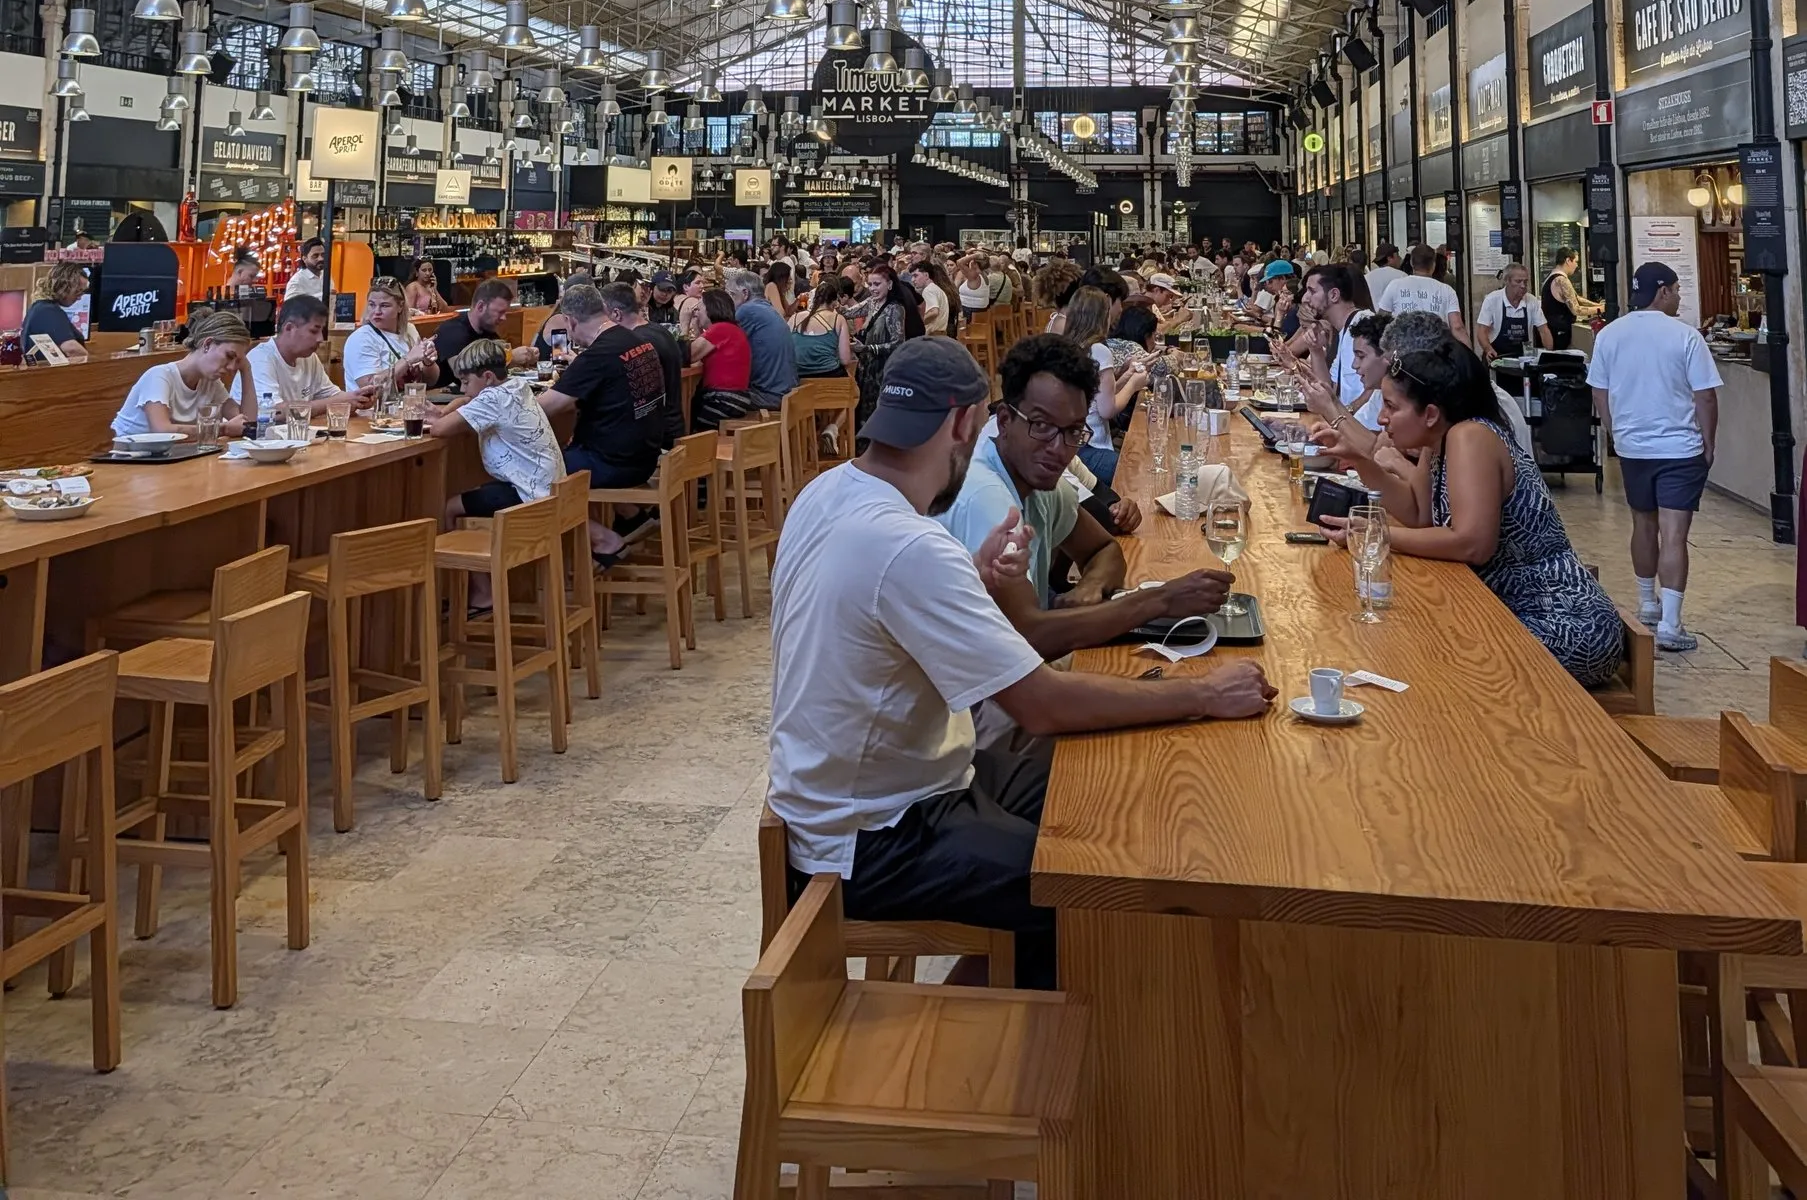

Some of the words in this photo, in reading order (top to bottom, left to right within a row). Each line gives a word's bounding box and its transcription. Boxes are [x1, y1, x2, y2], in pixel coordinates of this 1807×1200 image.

[1543, 36, 1585, 87] CROQUETERIA
[822, 96, 928, 112] MARKET
[856, 115, 894, 123] LISBOA
[328, 133, 364, 149] APEROL
[794, 142, 820, 150] ACADEMIA
[213, 140, 241, 160] GELATO
[241, 143, 273, 162] DAVVERO
[334, 144, 358, 155] SPRITZ
[804, 180, 855, 191] MANTEIGARIA
[416, 212, 445, 229] CASA
[447, 212, 461, 229] DE
[462, 212, 498, 229] VINHOS
[111, 290, 158, 312] APEROL
[119, 303, 151, 319] SPRITZ
[882, 384, 914, 398] MUSTO
